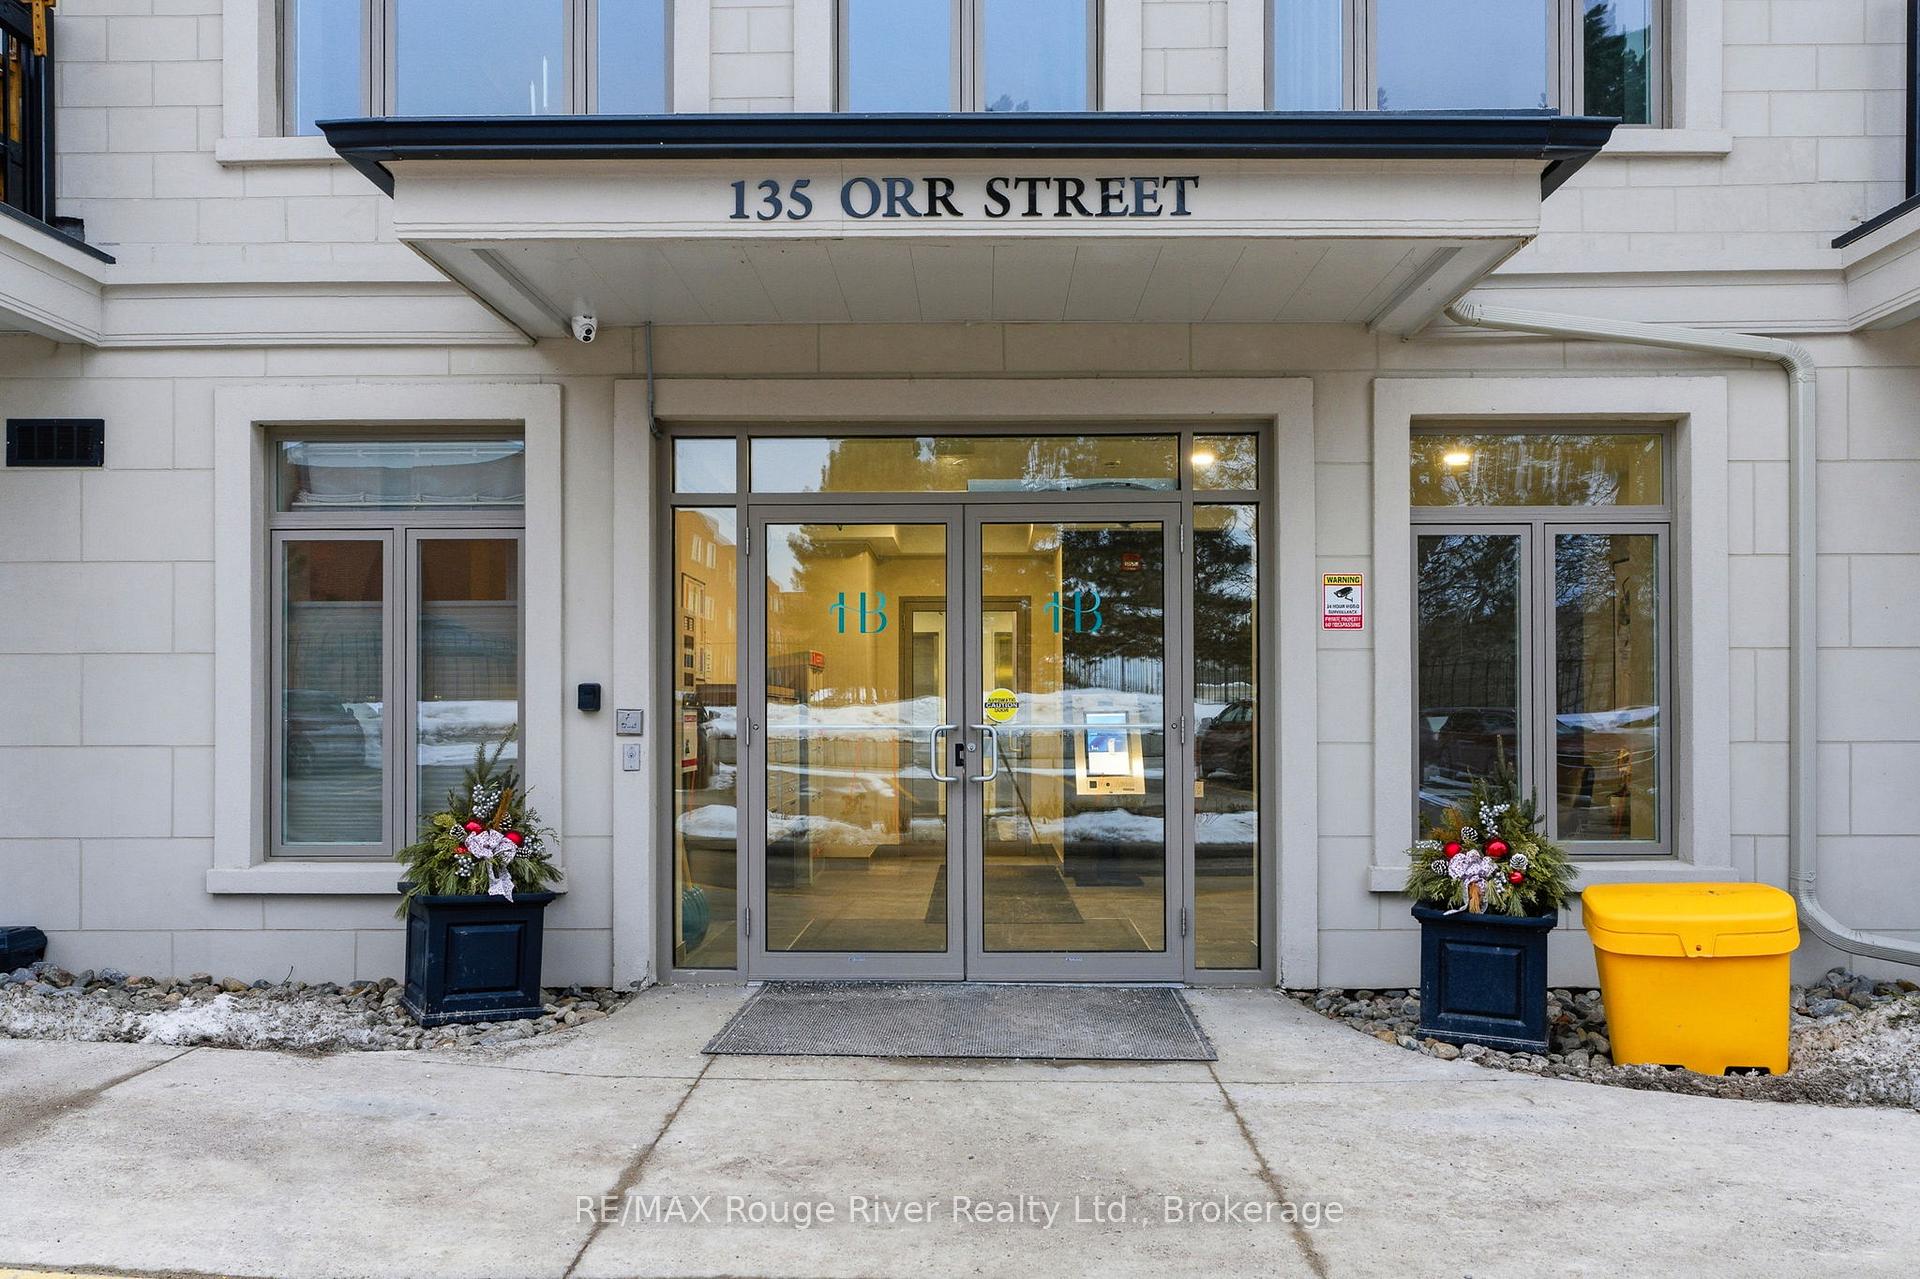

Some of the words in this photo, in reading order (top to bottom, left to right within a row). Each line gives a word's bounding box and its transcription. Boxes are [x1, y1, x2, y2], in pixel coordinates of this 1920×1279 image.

[729, 179, 813, 220] 135
[840, 176, 963, 219] ORR
[984, 175, 1200, 218] STREET
